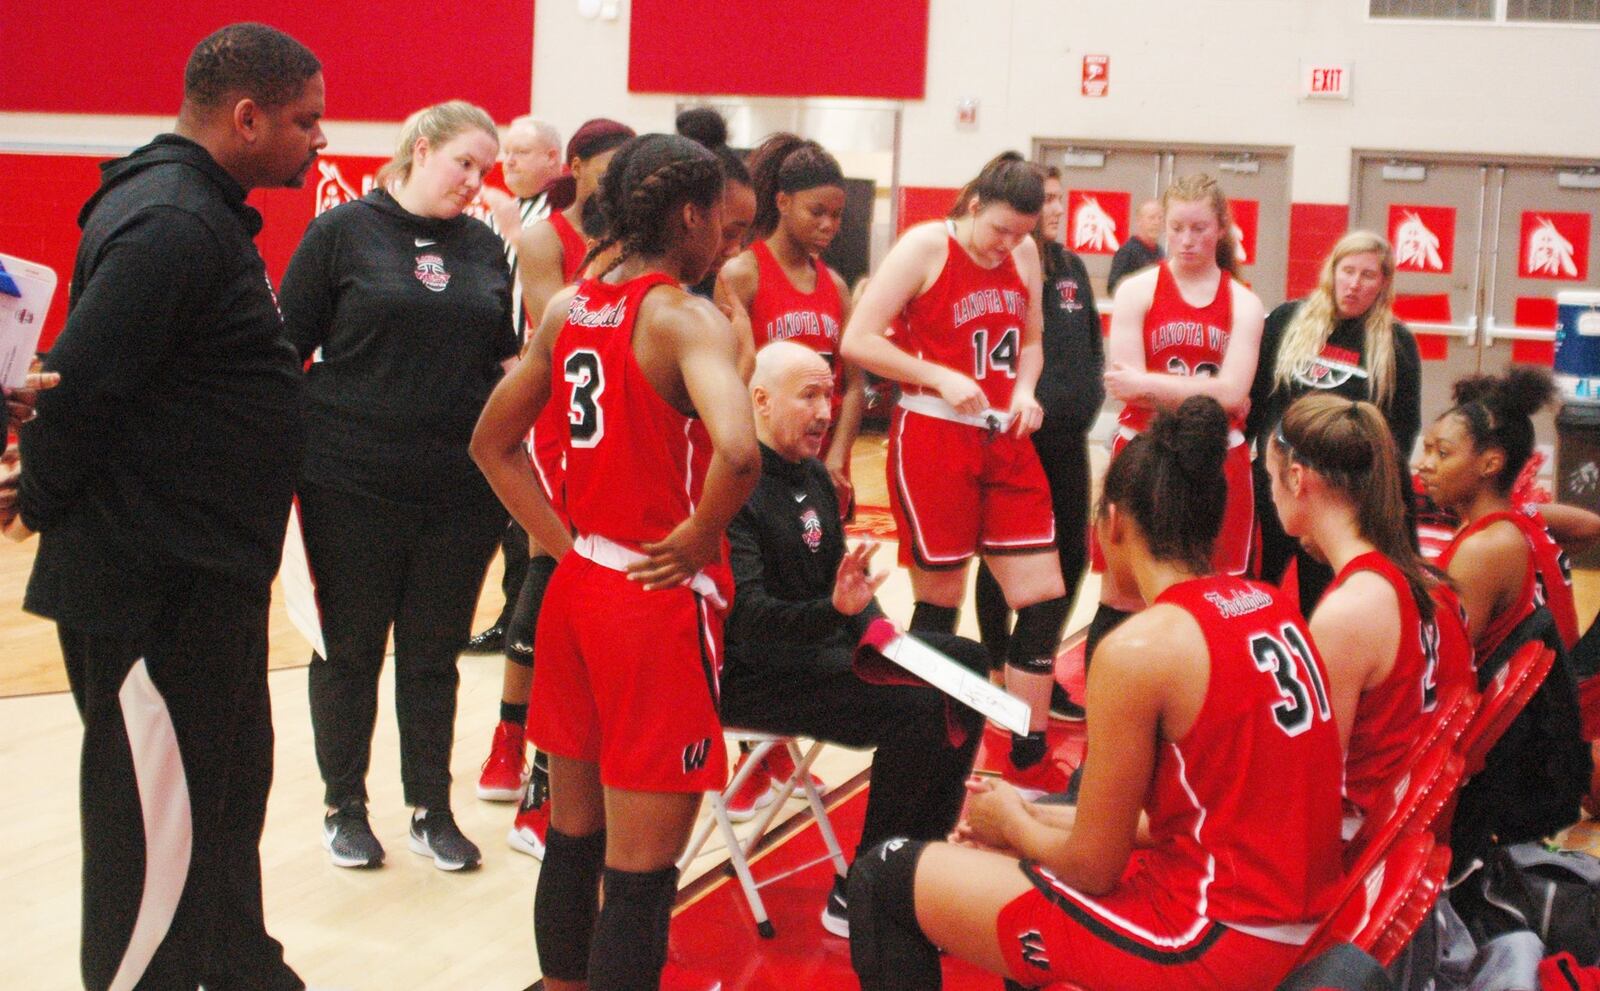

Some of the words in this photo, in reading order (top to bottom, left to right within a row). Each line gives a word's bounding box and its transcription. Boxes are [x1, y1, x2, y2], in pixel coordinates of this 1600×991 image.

[1312, 69, 1343, 91] EXIT
[767, 311, 821, 343] LAKOTA
[953, 289, 1003, 328] LAKOTA
[972, 327, 1020, 380] 14
[1151, 321, 1204, 355] LAKOTA
[564, 349, 606, 449] 3
[1249, 621, 1332, 738] 31
